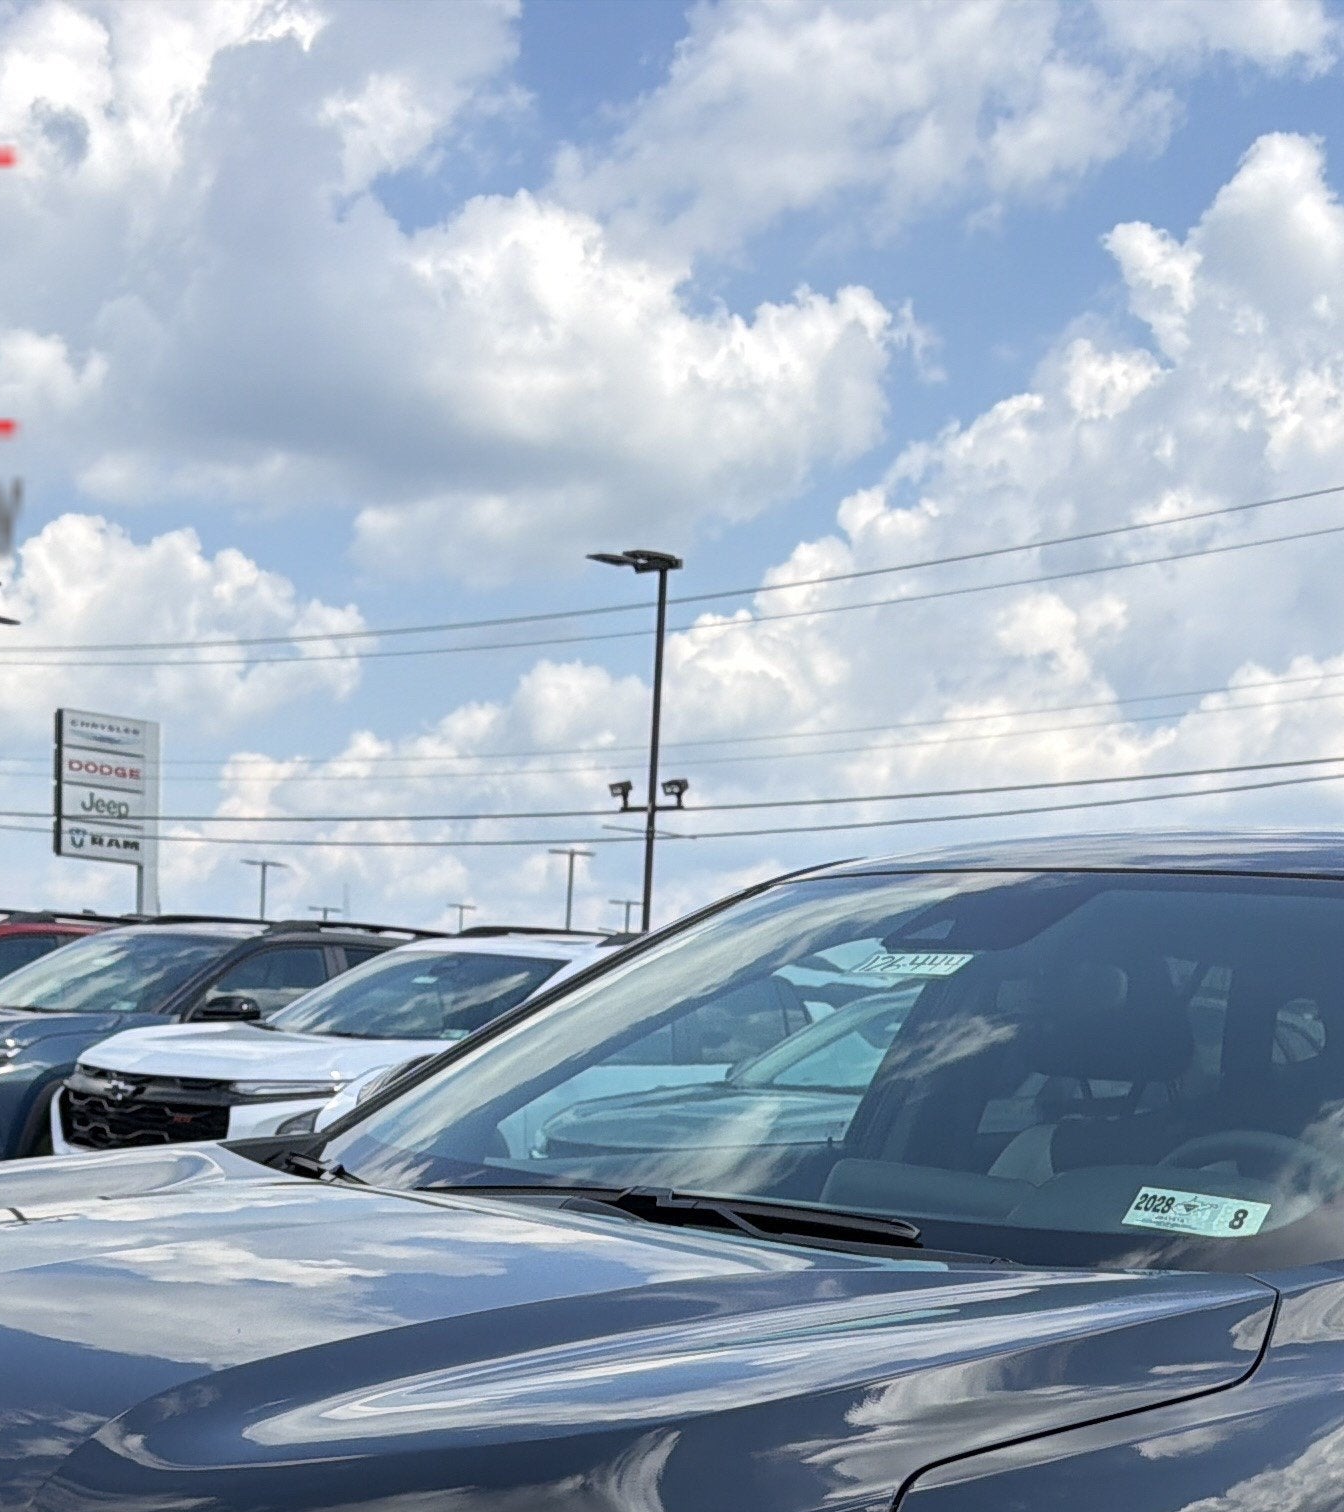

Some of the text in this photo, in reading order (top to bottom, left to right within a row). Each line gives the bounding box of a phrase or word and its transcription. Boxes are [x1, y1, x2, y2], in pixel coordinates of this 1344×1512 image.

[68, 759, 141, 780] DODGE
[81, 792, 130, 818] Jeep
[90, 834, 140, 851] RAM
[1134, 1193, 1249, 1230] 2028 8
